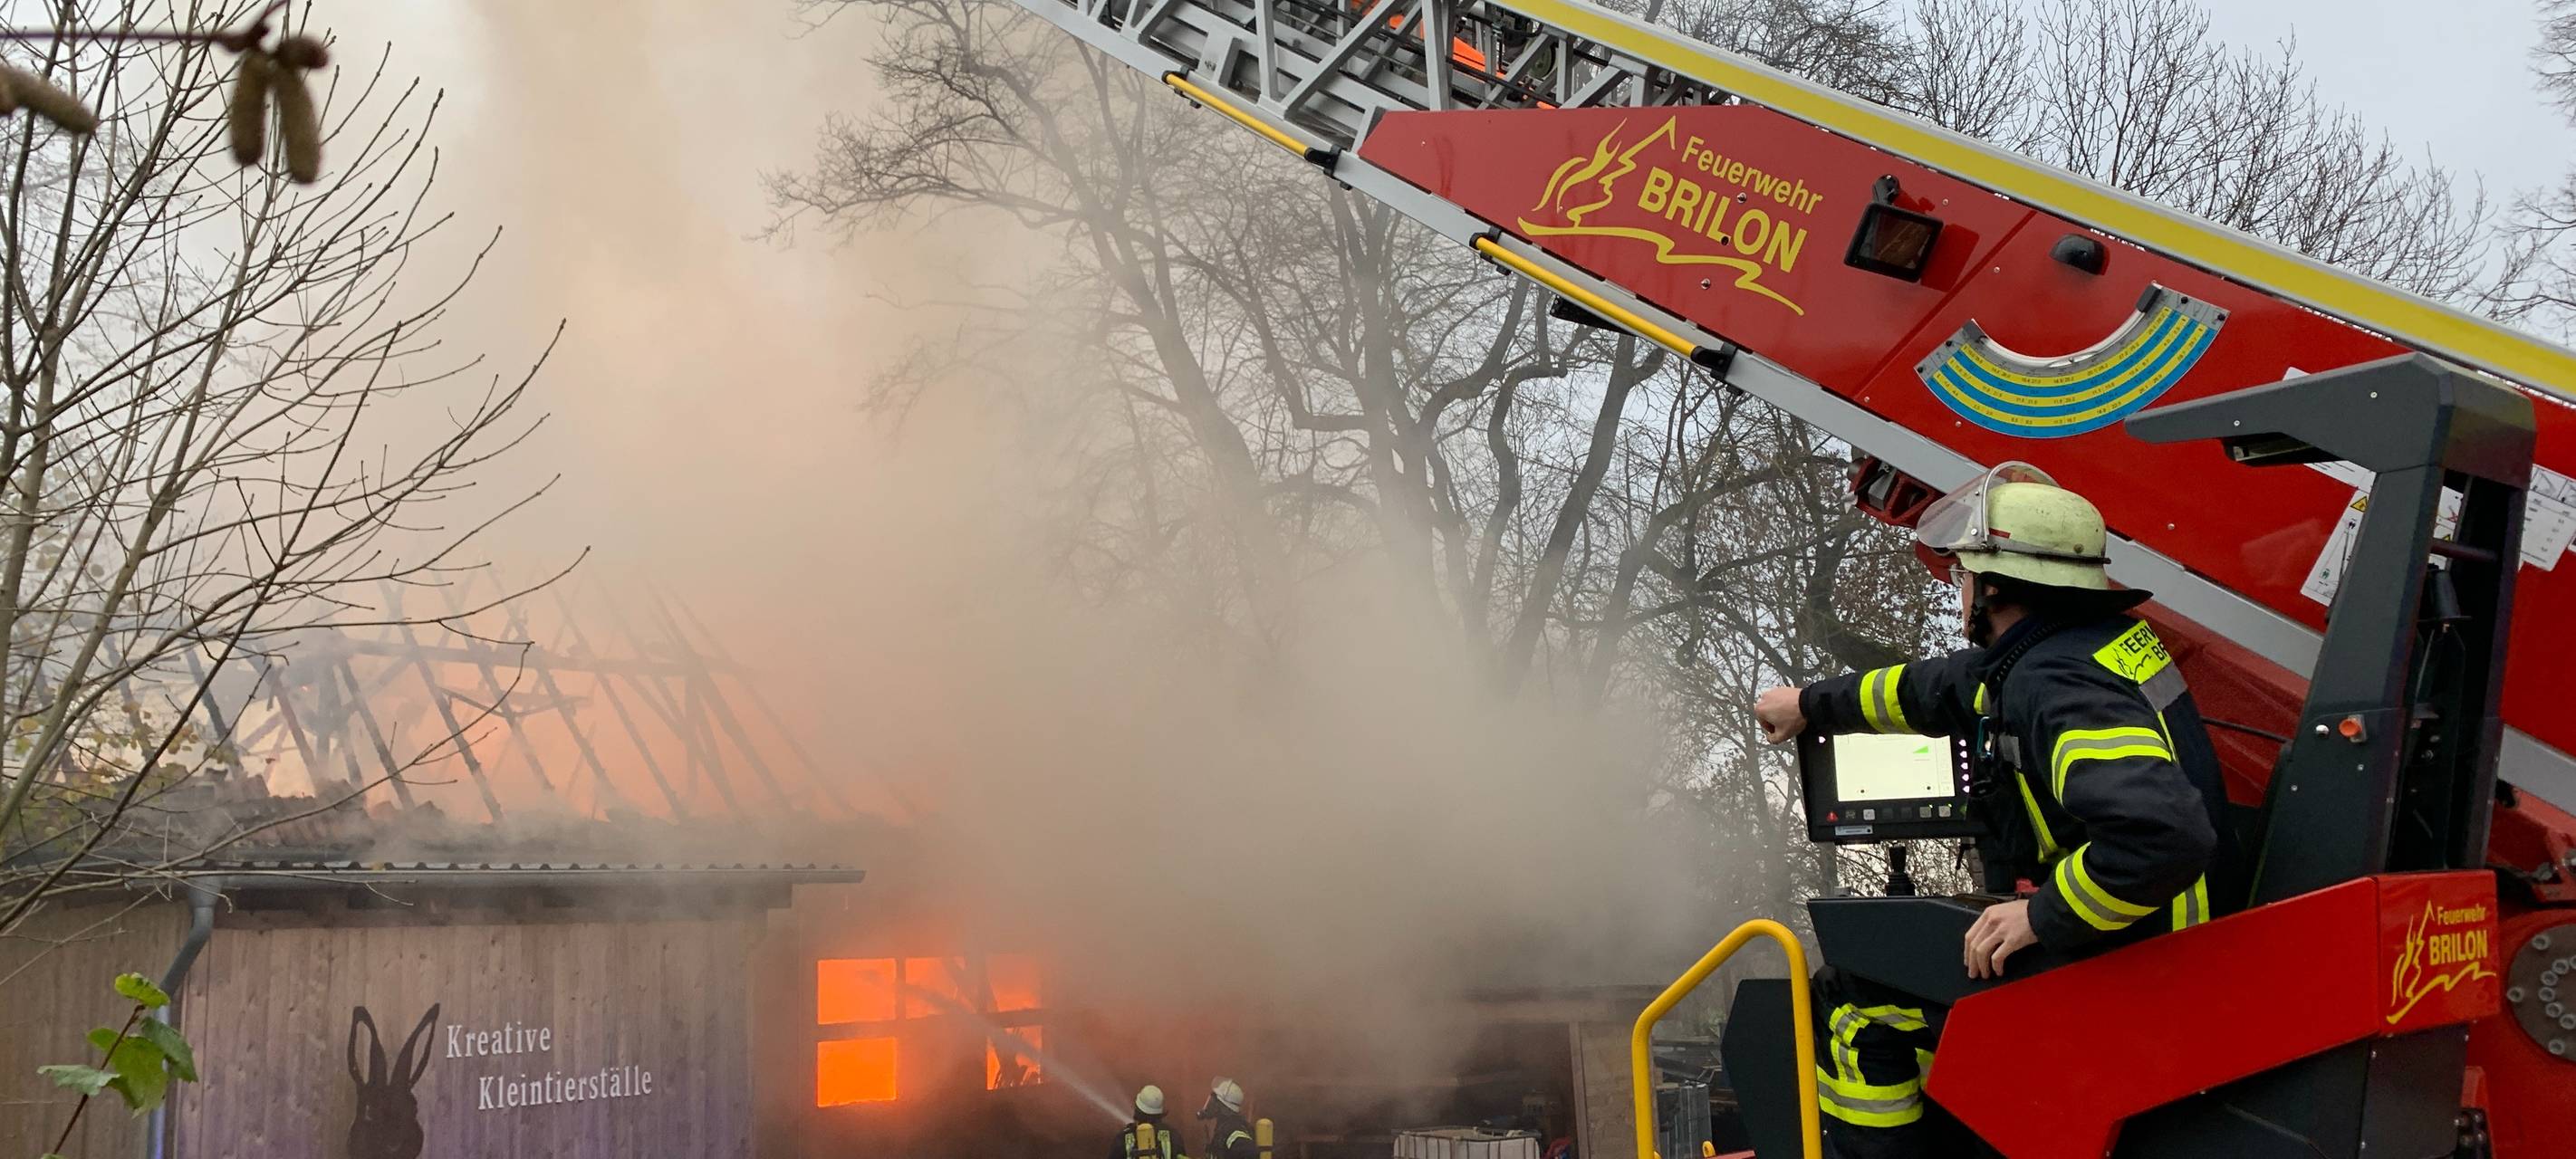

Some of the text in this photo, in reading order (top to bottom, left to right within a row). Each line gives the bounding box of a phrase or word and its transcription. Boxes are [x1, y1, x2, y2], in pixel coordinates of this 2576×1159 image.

[1682, 136, 1822, 214] Feuerwehr
[1638, 167, 1806, 273] BRILON
[2437, 904, 2485, 924] Feuerwehr
[2429, 930, 2487, 965] BRILON
[447, 1021, 551, 1058] Kreative
[478, 1065, 652, 1110] Kleintierställe
